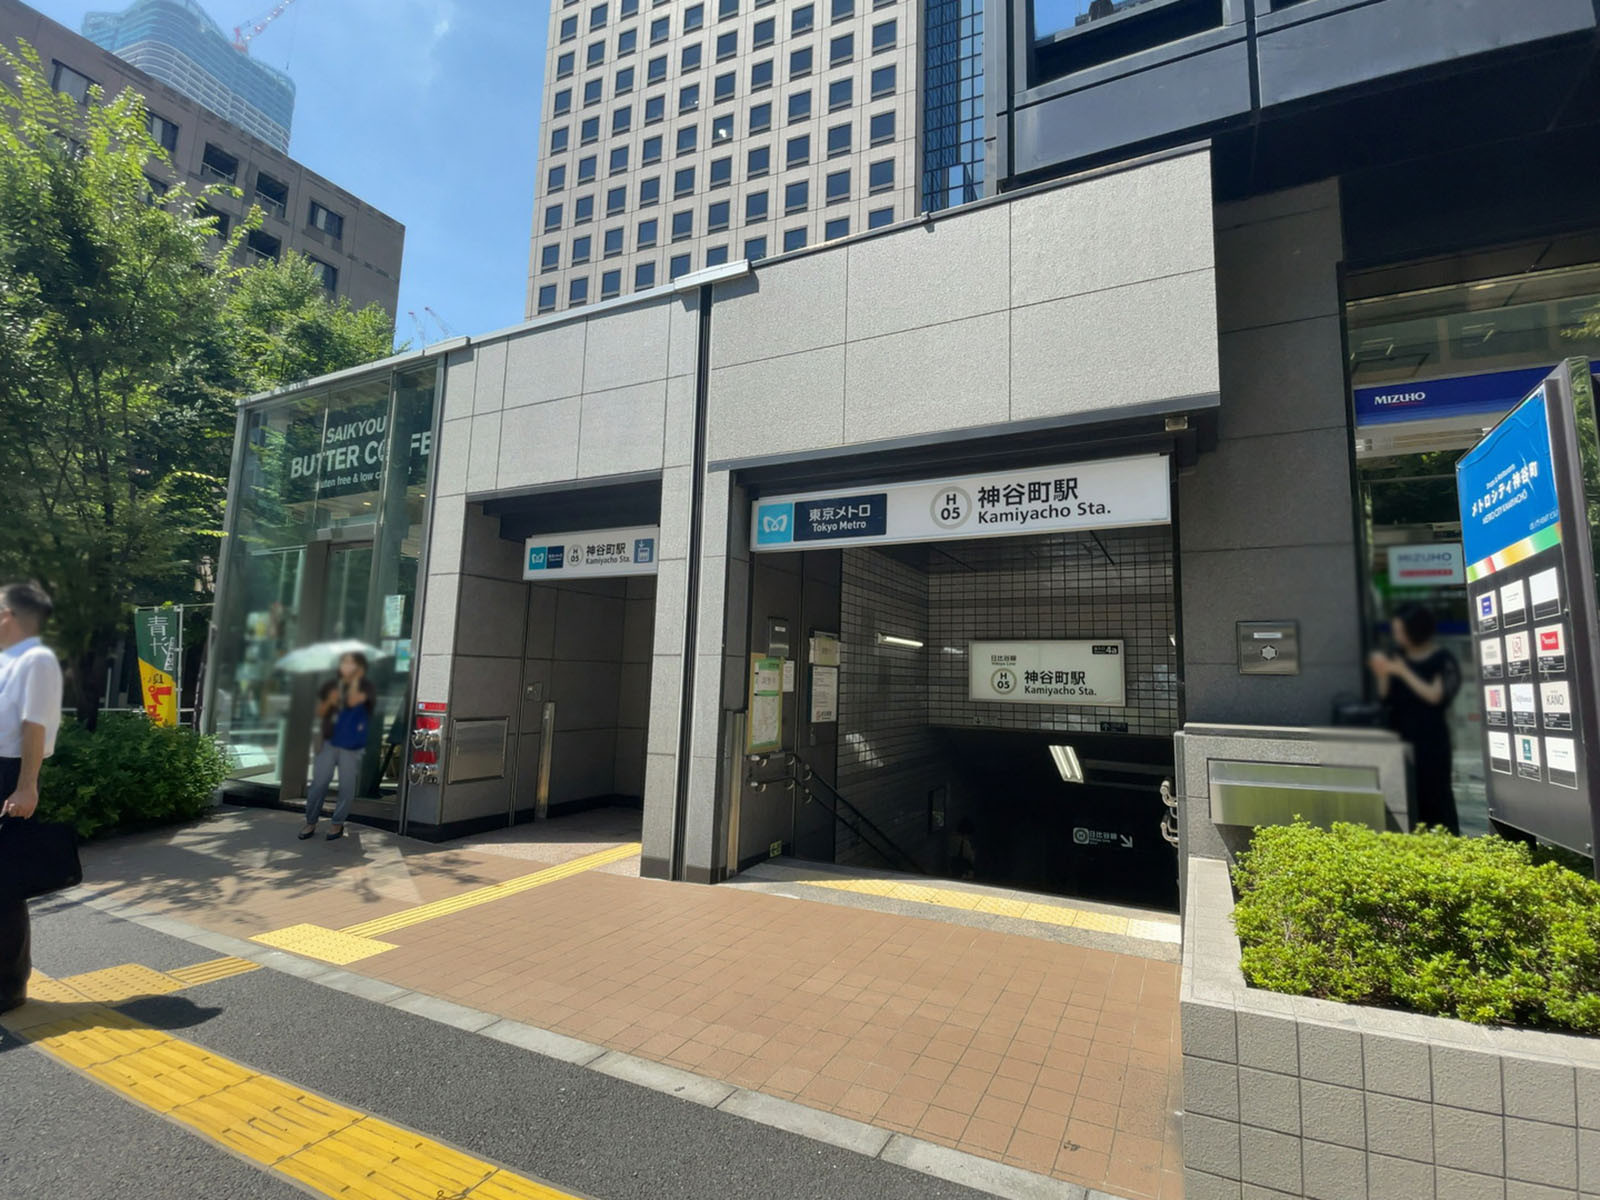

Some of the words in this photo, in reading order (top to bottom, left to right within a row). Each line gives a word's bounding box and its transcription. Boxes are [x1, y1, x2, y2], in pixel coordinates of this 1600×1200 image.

[1374, 391, 1426, 405] MIZUHO
[326, 416, 387, 444] SAIKYOU
[290, 446, 359, 479] BUTTER
[337, 475, 351, 485] free
[360, 471, 374, 482] low
[946, 493, 957, 505] H
[978, 478, 1079, 508] 神谷町駅
[808, 504, 871, 522] 東京メトロ
[941, 507, 961, 520] 05
[978, 505, 1071, 525] Kamiyacho
[1077, 502, 1112, 516] Sta.
[813, 522, 838, 533] Tokyo
[839, 520, 867, 531] Metro
[586, 542, 626, 556] 神谷町駅
[997, 681, 1010, 689] 05
[1024, 671, 1086, 685] 神谷町駅
[1024, 685, 1076, 696] Kamiyacho
[1079, 685, 1097, 696] Sta.
